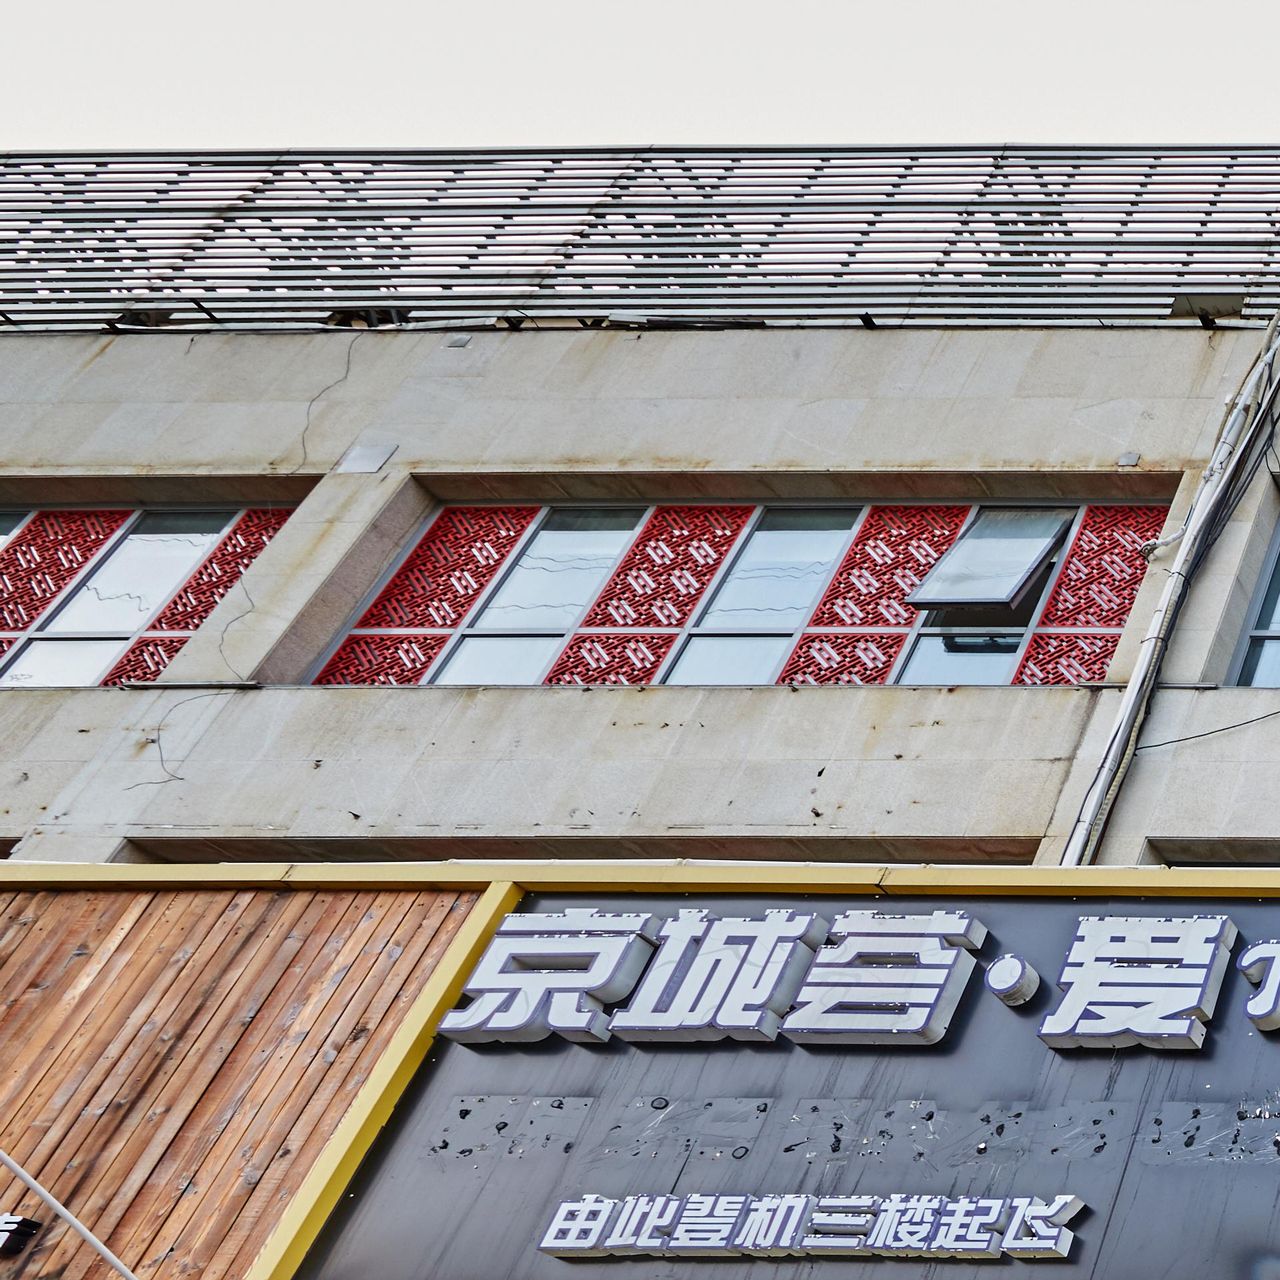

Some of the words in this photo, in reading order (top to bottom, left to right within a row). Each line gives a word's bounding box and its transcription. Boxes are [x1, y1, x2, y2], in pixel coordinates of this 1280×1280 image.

[537, 1192, 1093, 1259] 由此登机三楼起飞
